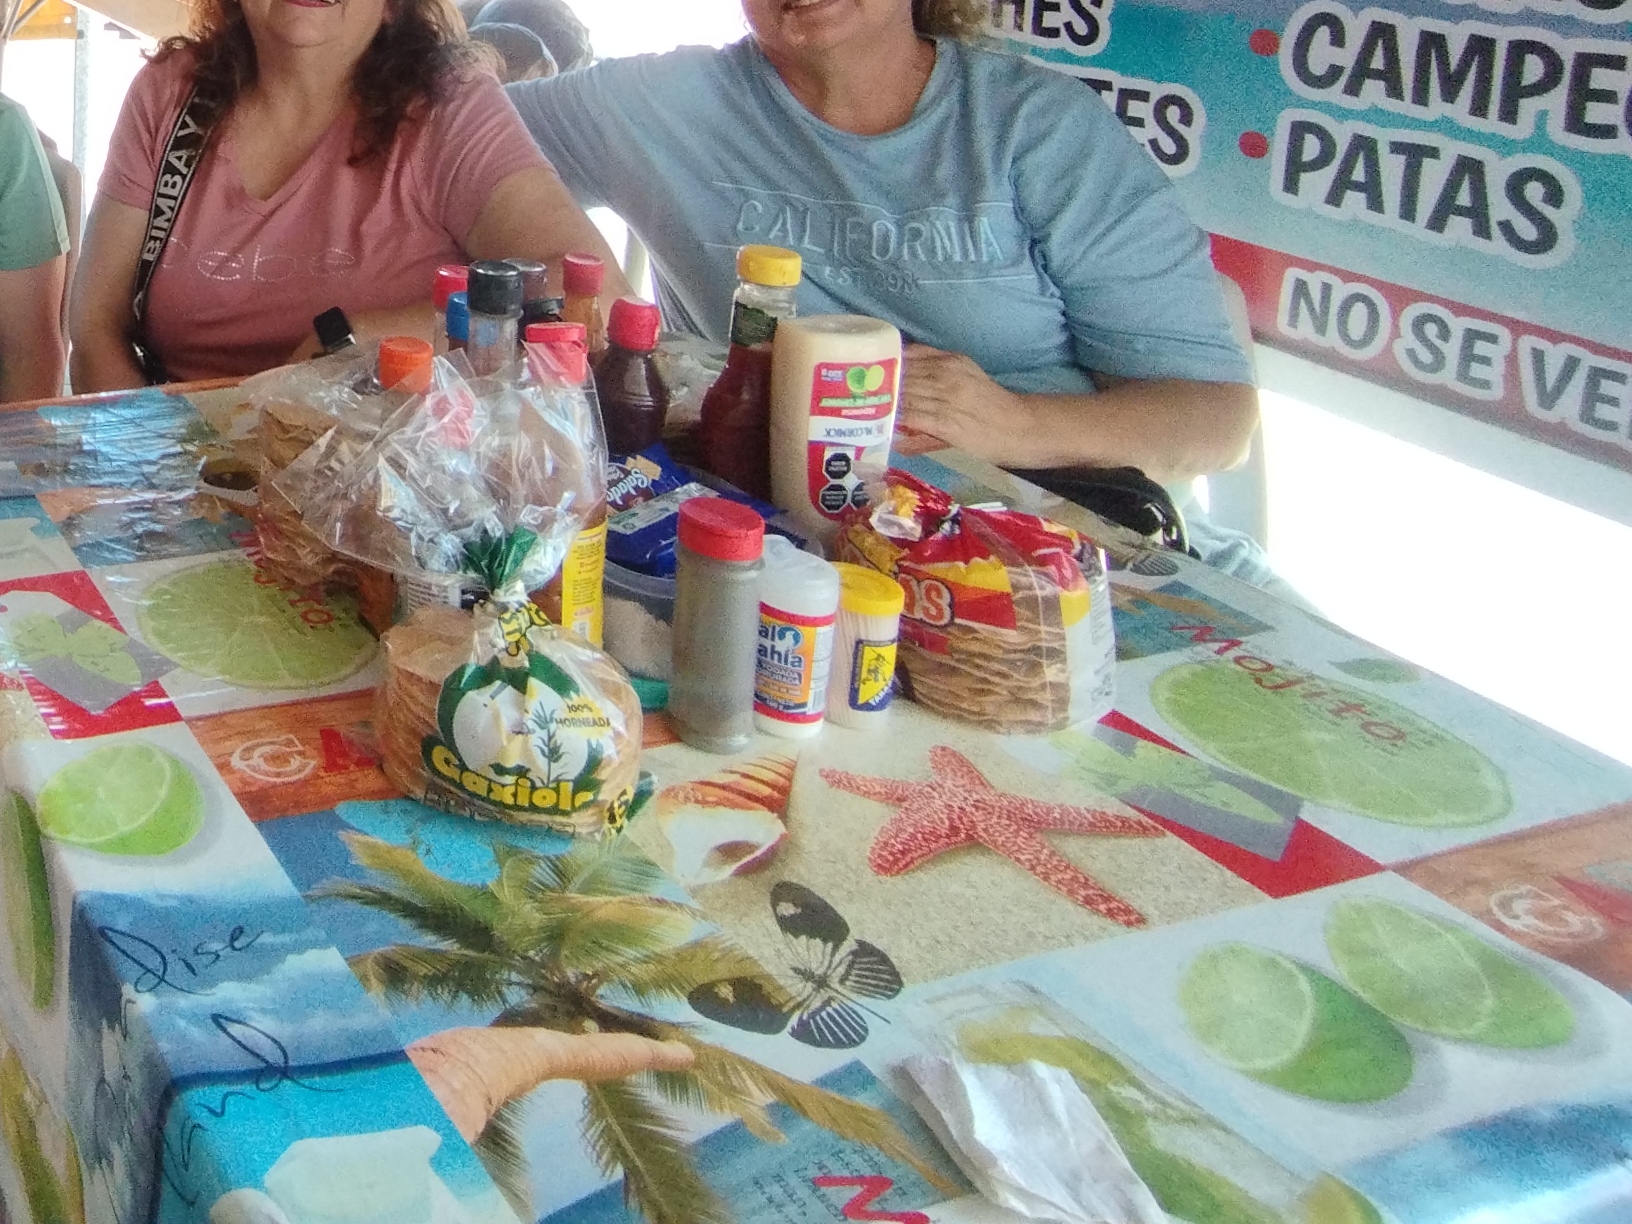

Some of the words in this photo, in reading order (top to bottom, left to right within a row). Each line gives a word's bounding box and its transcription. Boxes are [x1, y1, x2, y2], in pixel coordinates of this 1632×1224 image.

[1291, 10, 1632, 140] CAMPE
[737, 199, 1003, 263] CALIFORNIA
[1282, 120, 1566, 257] PATAS
[1287, 277, 1380, 351] NO
[1405, 312, 1500, 391] SE
[1530, 347, 1632, 441] VE
[567, 702, 593, 715] 100%
